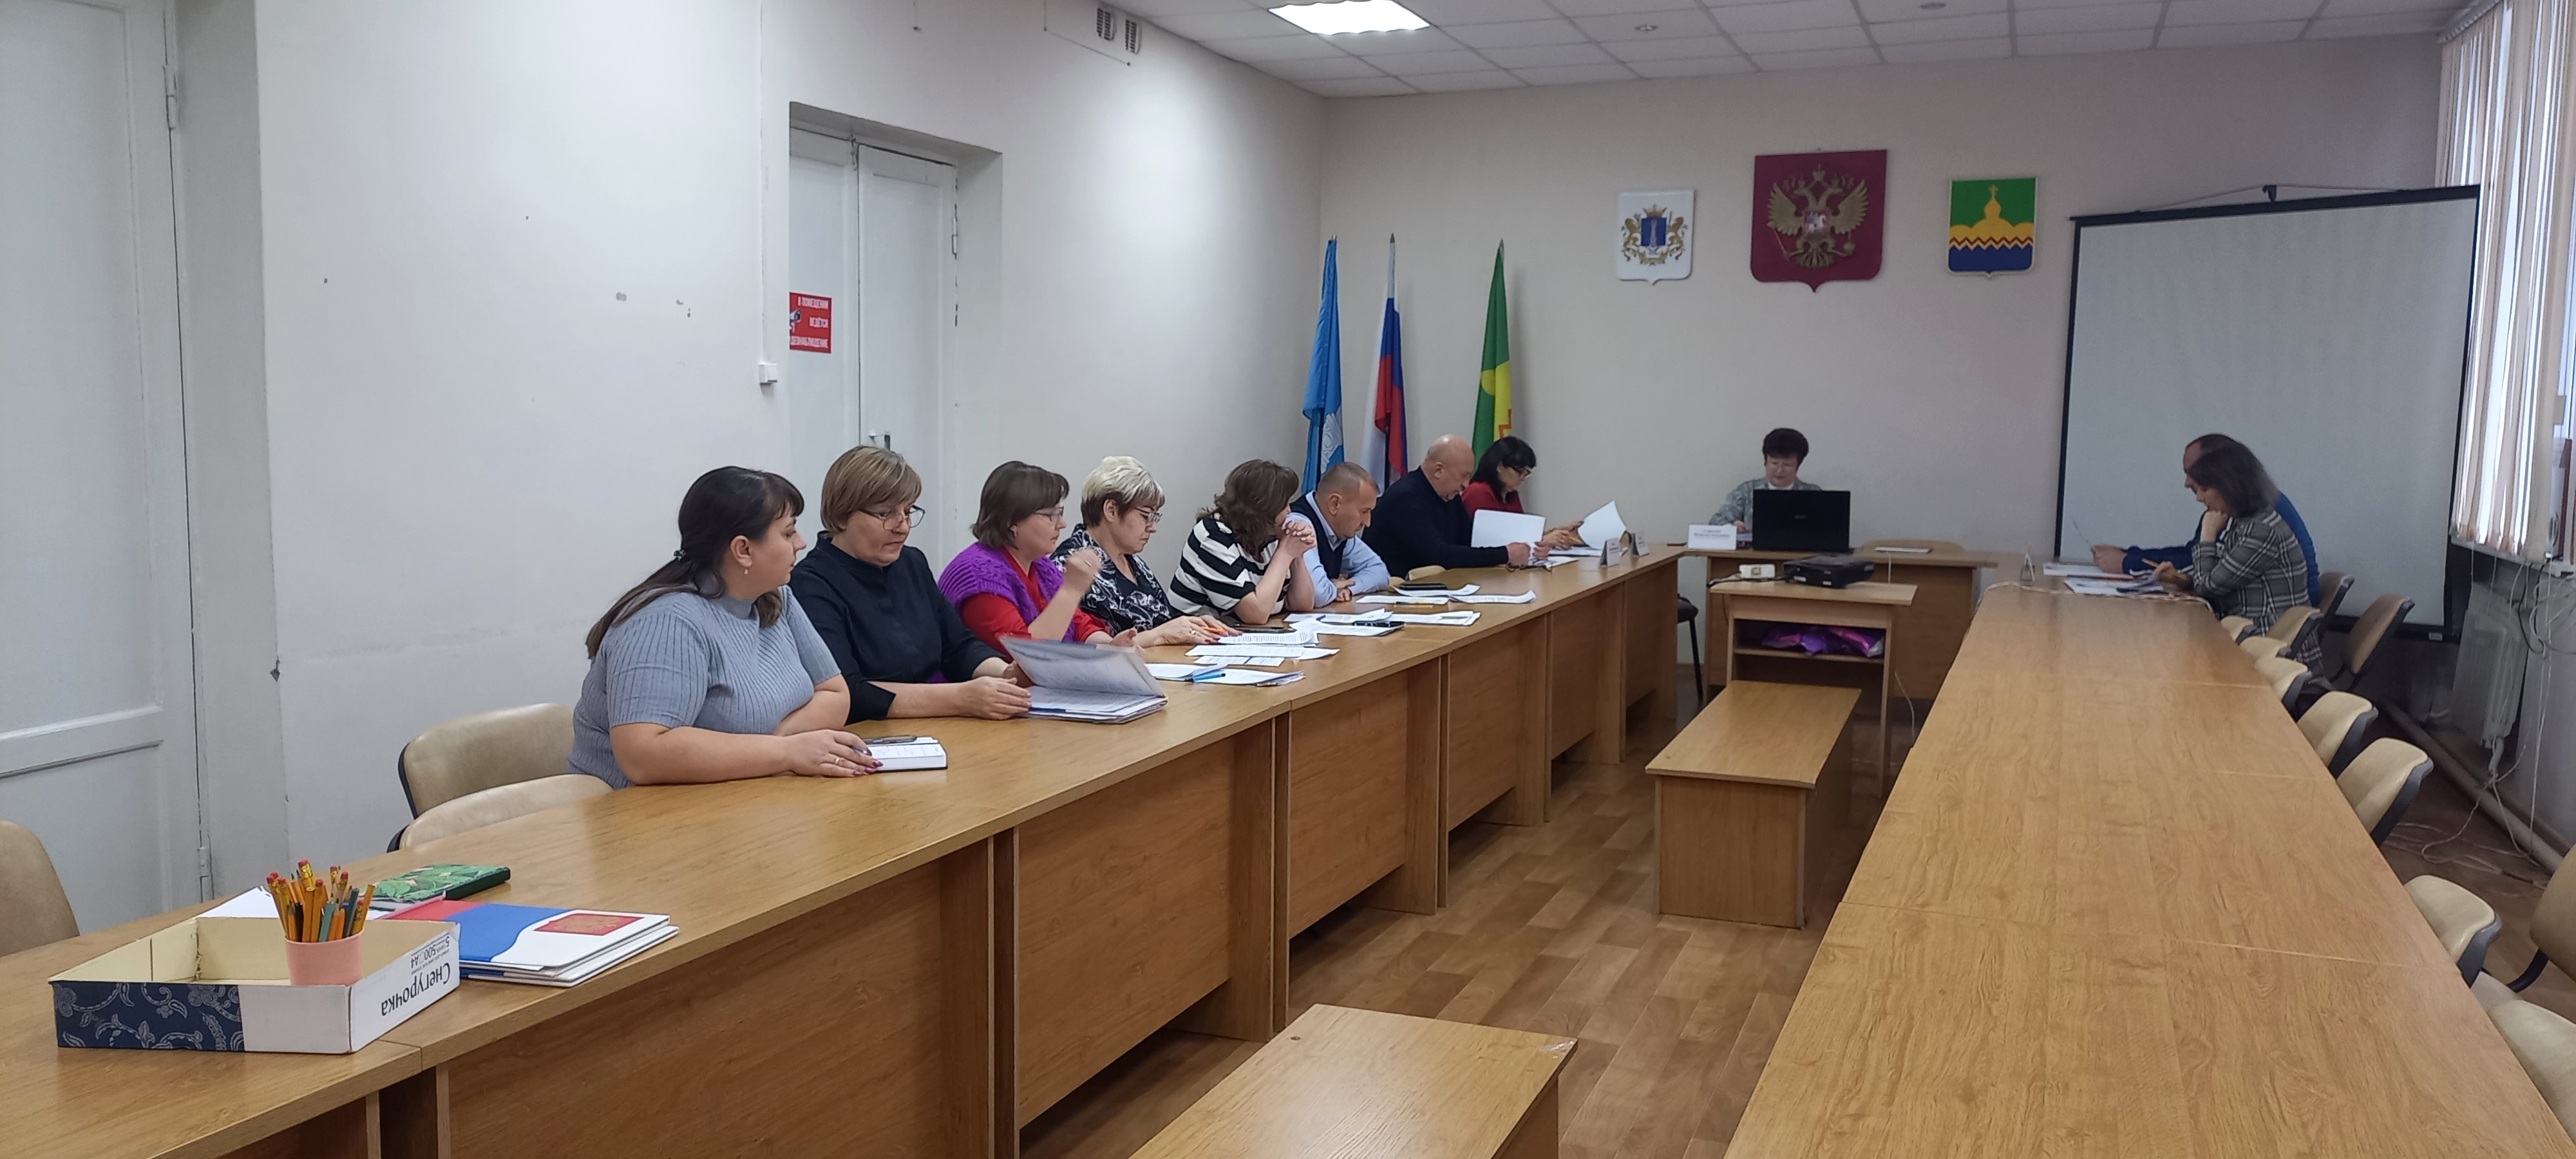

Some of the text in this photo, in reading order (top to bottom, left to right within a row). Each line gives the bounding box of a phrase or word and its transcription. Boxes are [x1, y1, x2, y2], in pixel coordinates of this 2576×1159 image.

[445, 936, 450, 947] 5
[424, 945, 436, 961] 500
[381, 962, 450, 1016] Снегурочка
